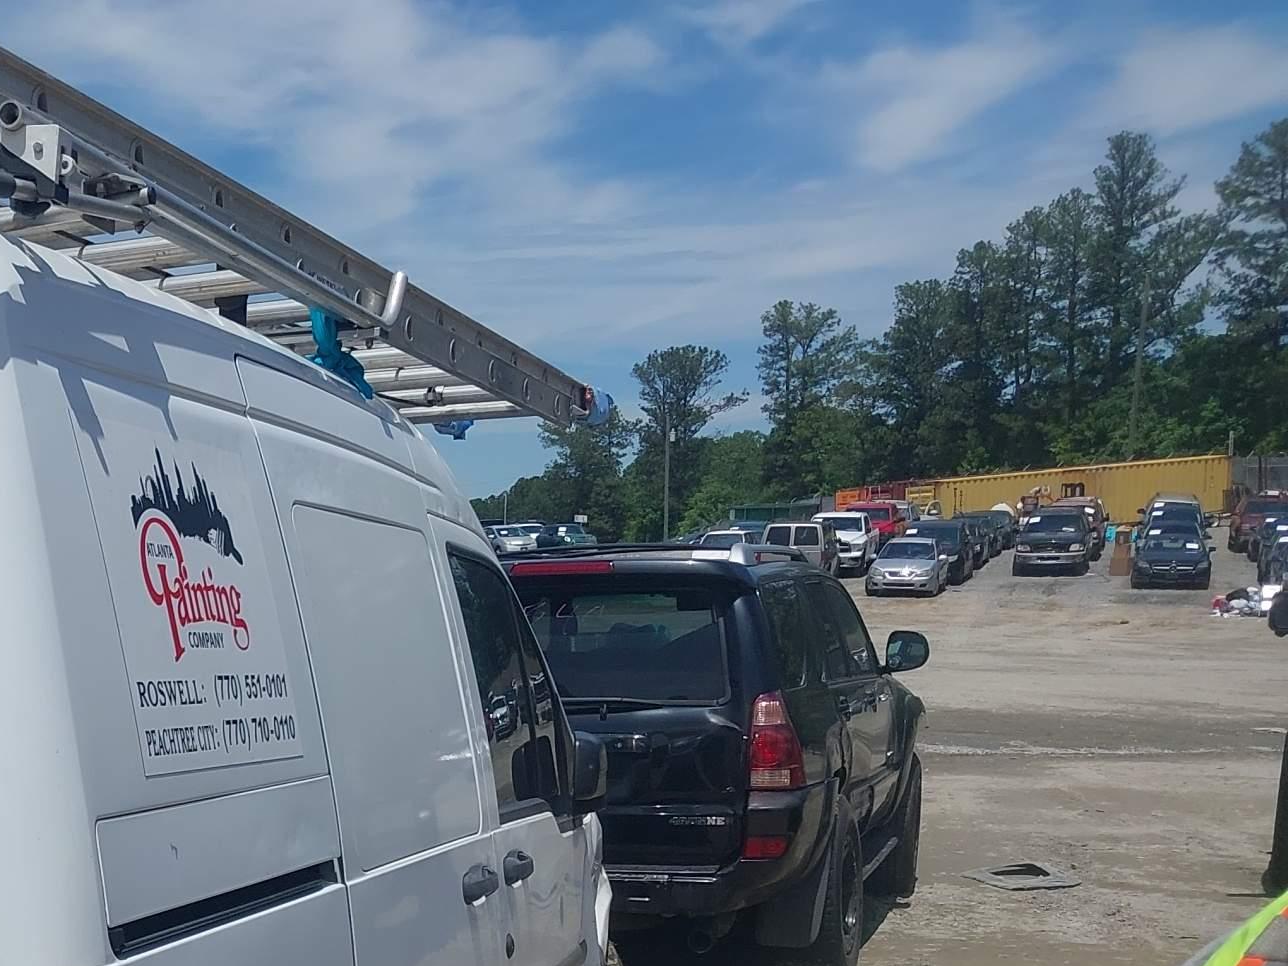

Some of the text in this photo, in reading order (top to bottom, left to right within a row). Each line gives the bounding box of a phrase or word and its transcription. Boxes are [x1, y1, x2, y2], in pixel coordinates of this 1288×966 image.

[146, 542, 174, 559] ATLANTA
[140, 517, 249, 661] Painting
[188, 631, 224, 648] COMPANY
[136, 673, 288, 708] ROSWELL: (770) 551-0101
[145, 714, 296, 757] PEACHTREE CITY: (770) 710-0110
